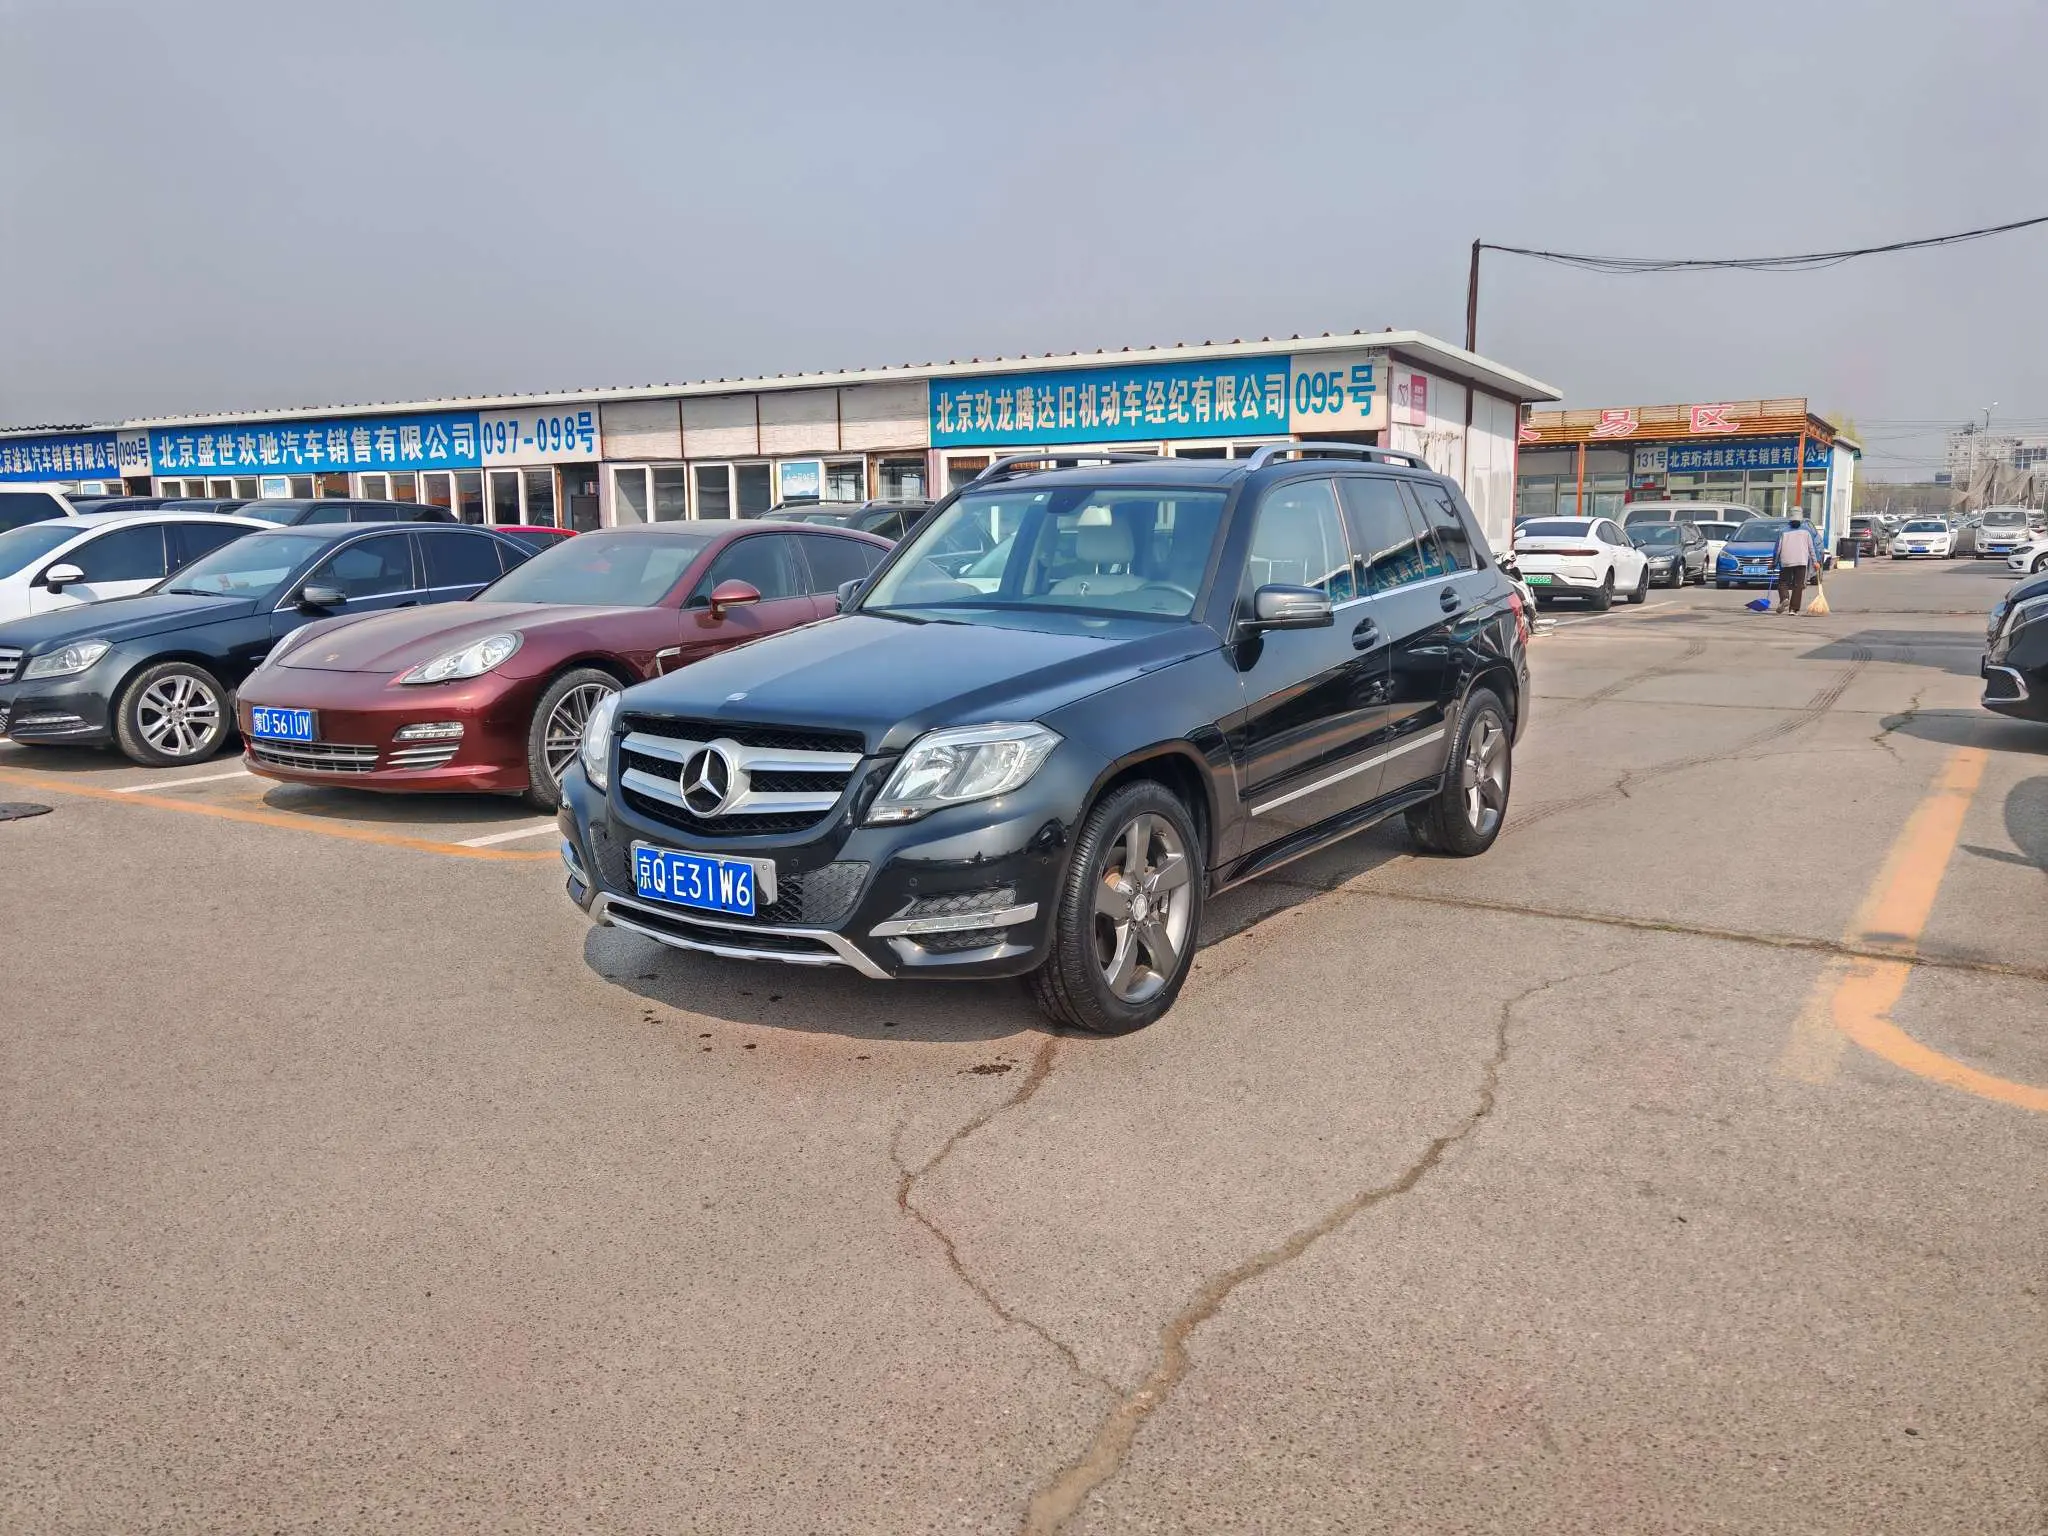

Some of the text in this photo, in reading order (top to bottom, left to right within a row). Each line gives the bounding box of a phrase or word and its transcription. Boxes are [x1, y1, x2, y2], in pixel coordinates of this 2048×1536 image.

[936, 374, 1286, 434] 北京玖龙腾达旧机动车经纪有限公司
[1295, 364, 1377, 417] 095号
[119, 437, 149, 467] 099号
[158, 422, 475, 468] 北京盛世欢驰汽车销售有限公司
[483, 411, 595, 454] 097-098号
[1635, 452, 1668, 469] 131号
[639, 855, 750, 907] 京Q·E31W6
